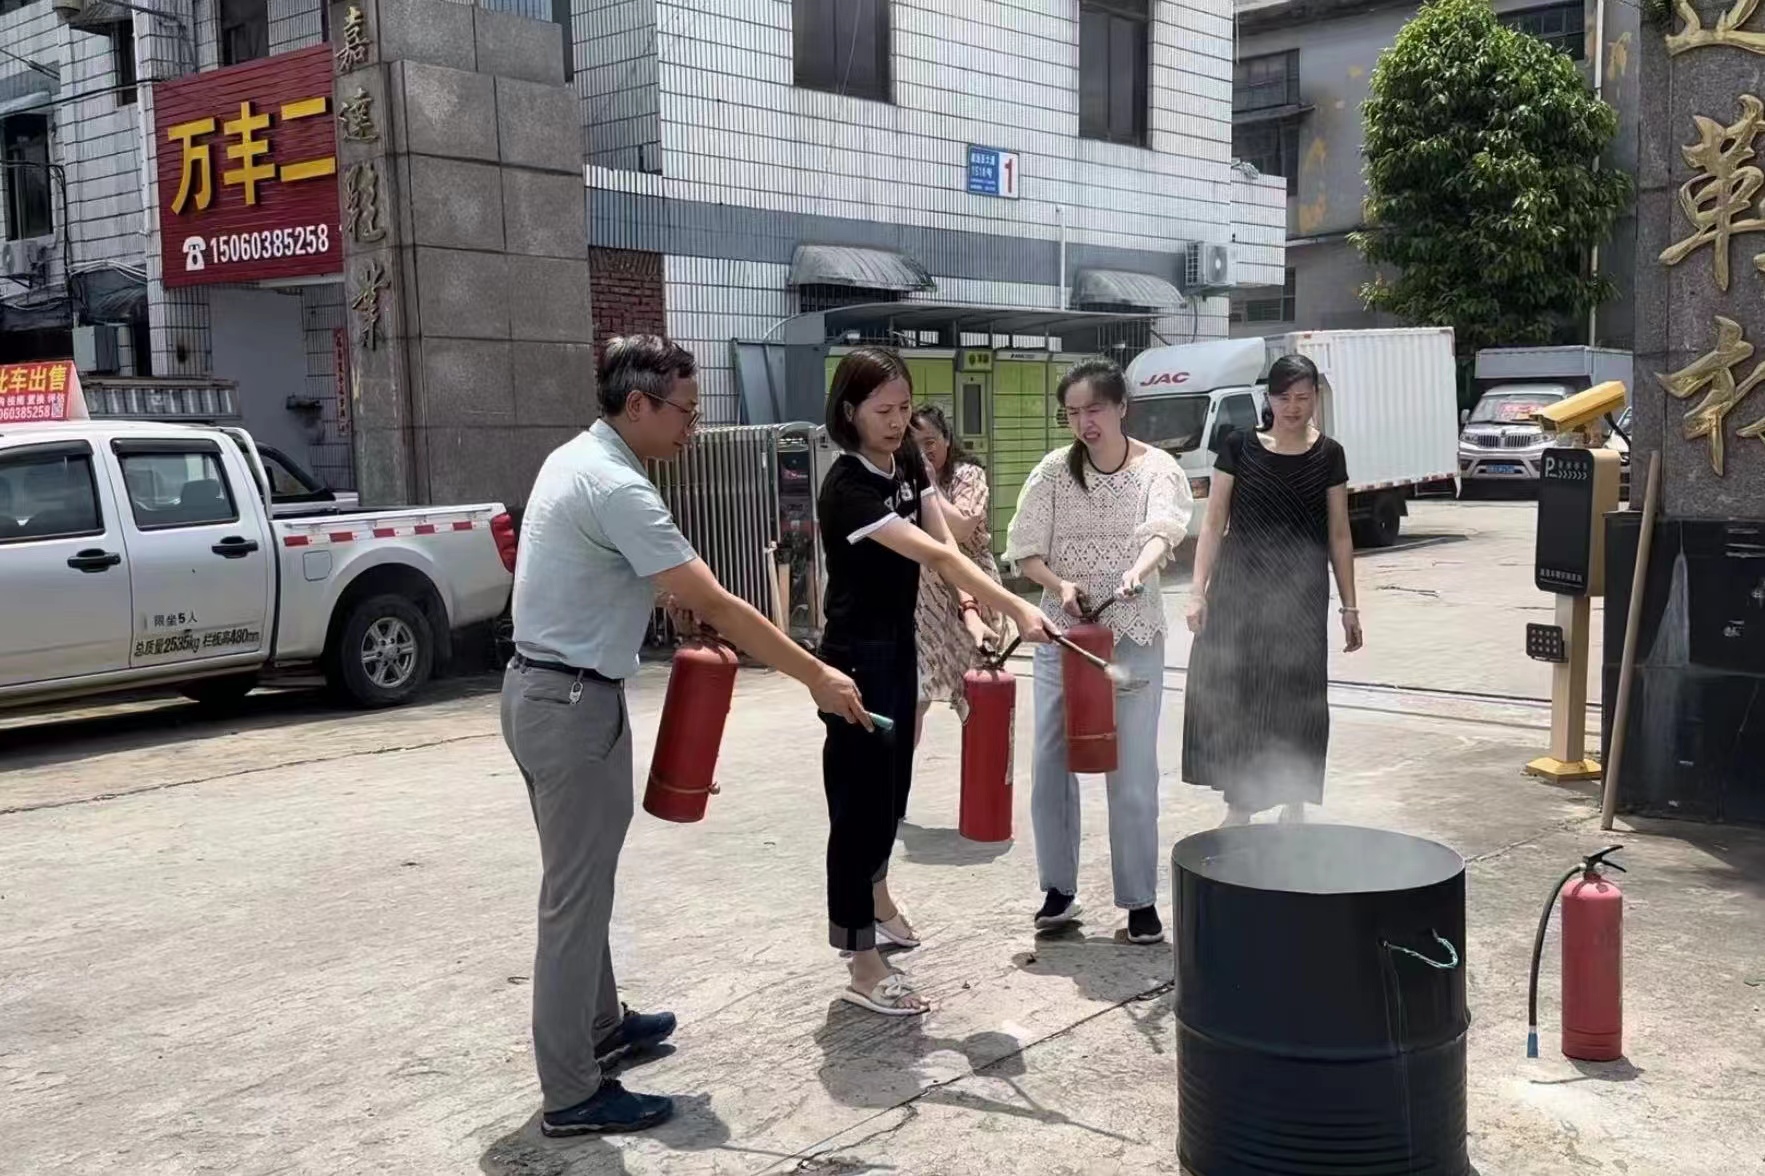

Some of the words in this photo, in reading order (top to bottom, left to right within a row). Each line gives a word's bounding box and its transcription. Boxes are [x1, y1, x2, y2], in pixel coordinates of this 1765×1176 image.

[210, 224, 329, 263] 15060385258
[1140, 371, 1190, 387] JAC
[154, 610, 198, 627] 限坐5人
